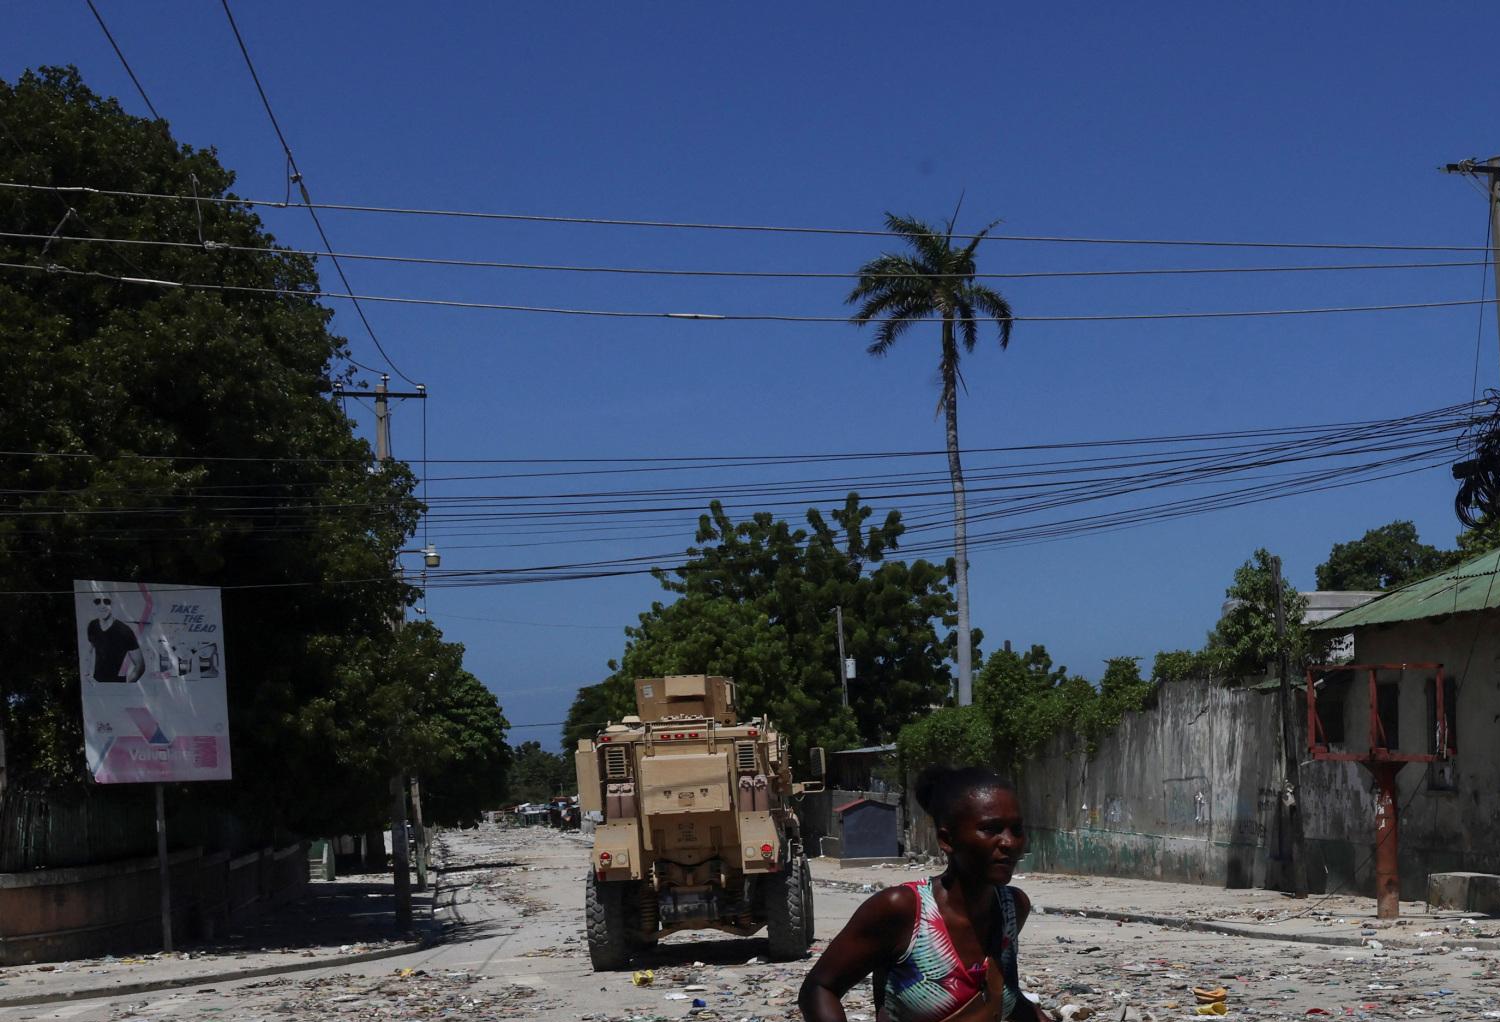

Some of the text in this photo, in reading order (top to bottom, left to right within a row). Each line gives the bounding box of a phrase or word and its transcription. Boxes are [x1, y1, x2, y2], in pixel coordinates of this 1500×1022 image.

[170, 605, 200, 613] TAKE
[184, 614, 205, 623] THE
[188, 623, 217, 632] LEAD
